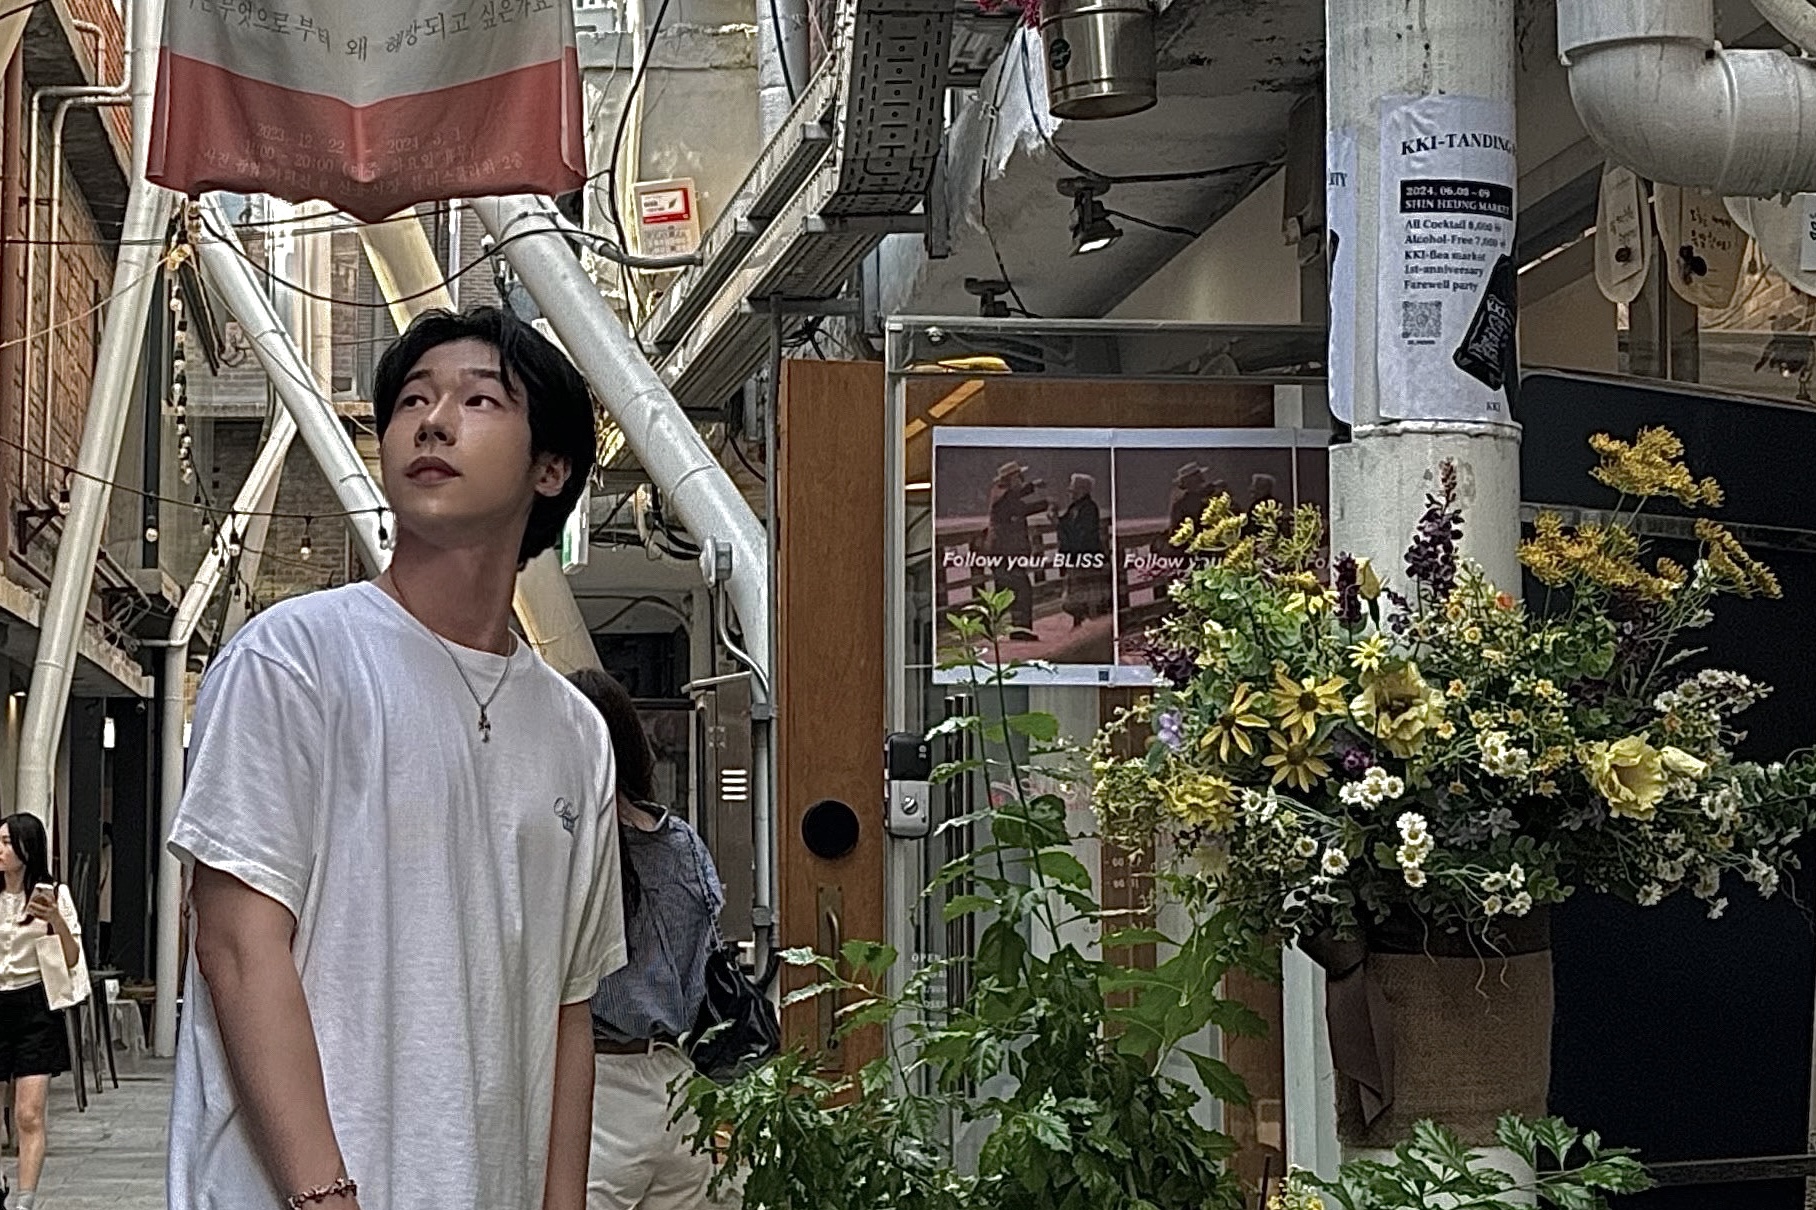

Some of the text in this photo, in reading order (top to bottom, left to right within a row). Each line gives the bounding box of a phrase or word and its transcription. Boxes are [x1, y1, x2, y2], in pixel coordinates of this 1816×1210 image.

[345, 36, 368, 63] 왜
[1405, 199, 1434, 209] SHIN
[1437, 199, 1477, 211] HEUNG
[1405, 219, 1420, 230] All
[1422, 219, 1466, 231] Cocktail
[1404, 234, 1473, 245] Alcohol-Free
[1451, 252, 1486, 262] market
[1404, 264, 1484, 278] 1st-anniversary
[1404, 280, 1478, 293] Farewell party
[942, 551, 1105, 571] Follow your BLISS
[1123, 552, 1224, 573] Follow you
